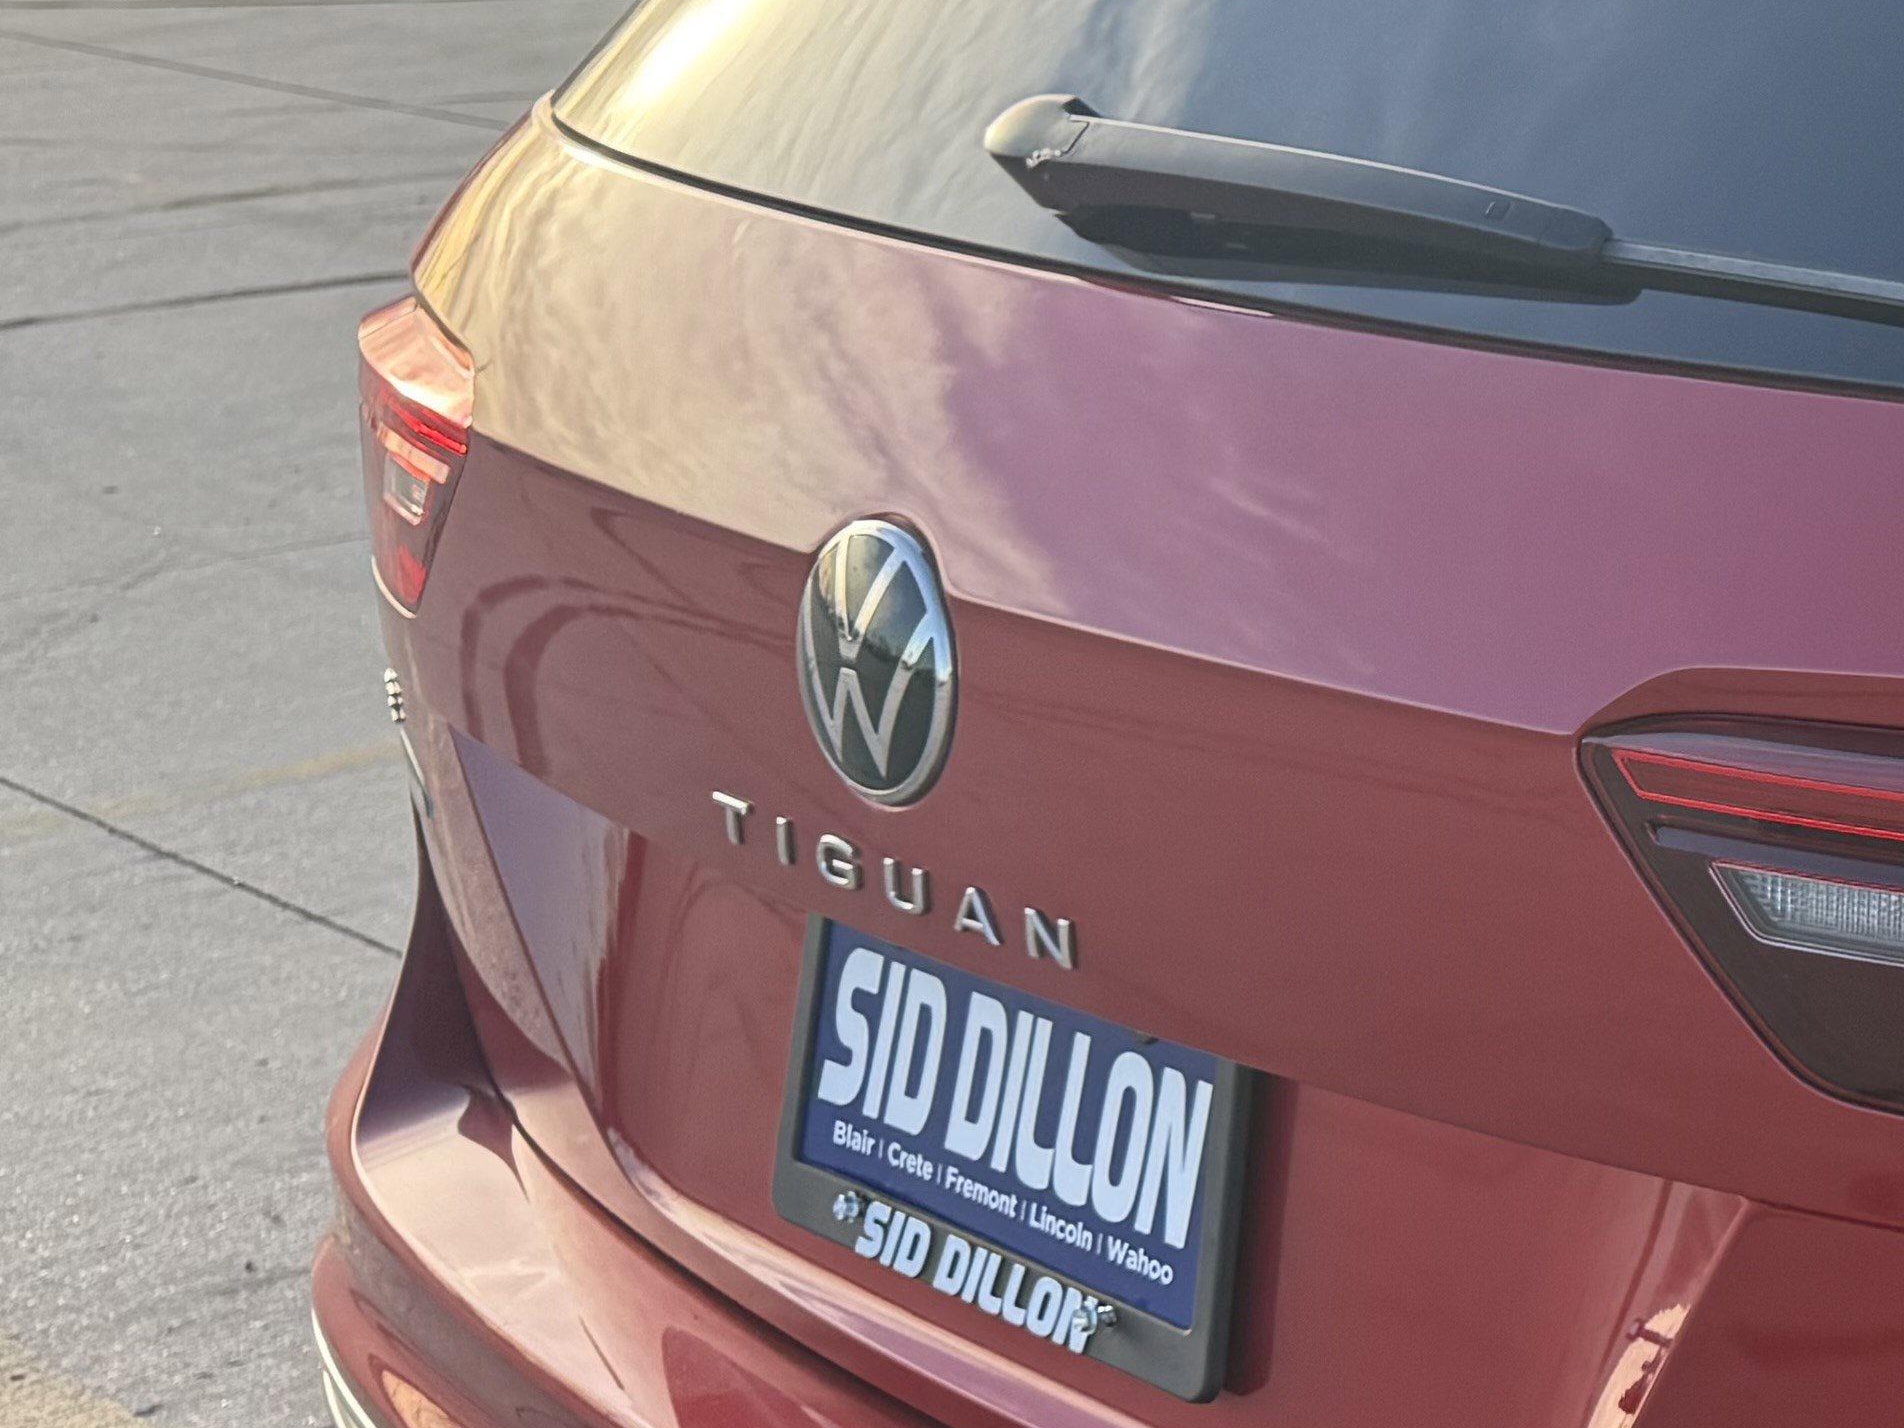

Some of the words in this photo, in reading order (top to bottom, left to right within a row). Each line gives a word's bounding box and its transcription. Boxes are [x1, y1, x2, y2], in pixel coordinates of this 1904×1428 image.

[711, 790, 1076, 970] TIGUAN
[817, 947, 947, 1136] SID
[944, 990, 1213, 1250] DILLON
[833, 1120, 875, 1157] Blair
[887, 1142, 933, 1182] Crete
[945, 1166, 1018, 1219] Fremont
[1029, 1206, 1093, 1251] Lincoln
[1108, 1235, 1174, 1285] Wahoo
[855, 1200, 932, 1278] SID
[932, 1234, 1098, 1354] DILLON
